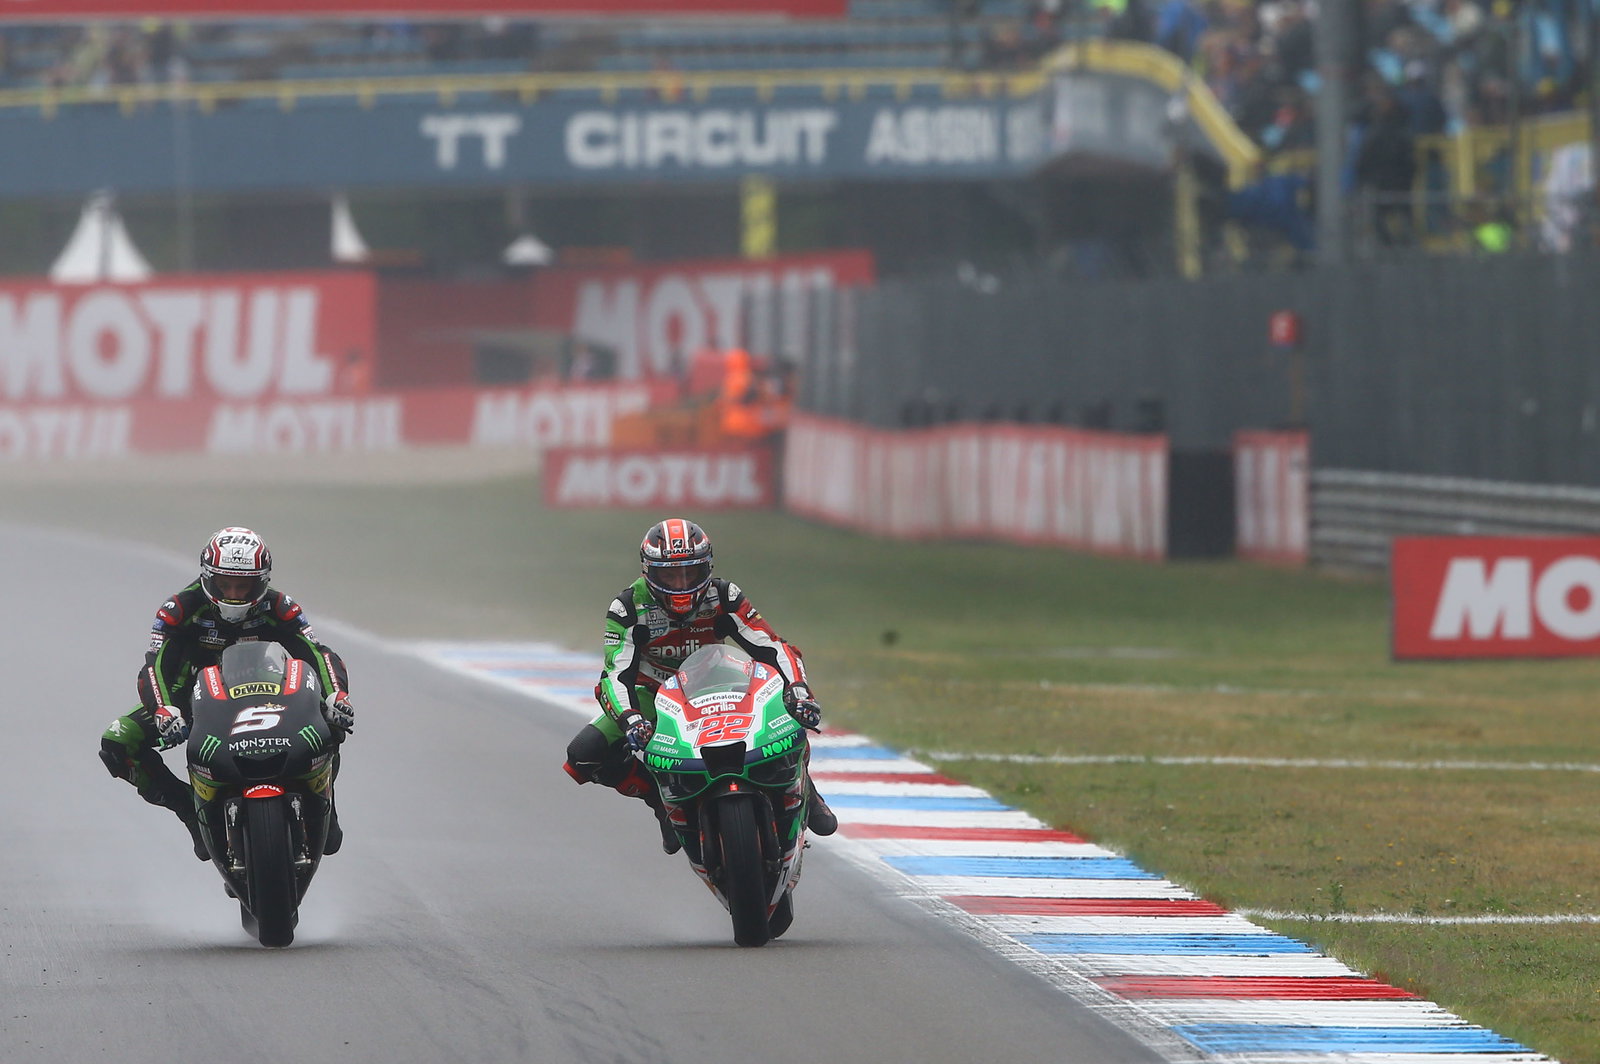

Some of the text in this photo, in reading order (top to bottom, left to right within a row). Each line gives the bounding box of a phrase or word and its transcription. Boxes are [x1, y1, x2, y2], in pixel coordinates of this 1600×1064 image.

[420, 114, 520, 168] TT
[565, 110, 837, 168] CIRCUIT
[0, 286, 336, 399] MOTUL
[558, 456, 762, 502] MOTUL
[649, 629, 664, 639] SAP
[289, 661, 298, 689] BARRACUDA
[692, 693, 743, 706] SuperEnalotto
[701, 703, 737, 715] aprilia
[231, 704, 287, 735] 5
[771, 715, 791, 727] MOTUL
[693, 714, 756, 748] 22
[776, 724, 795, 736] MARSH
[228, 737, 292, 752] MONSTER
[655, 735, 674, 743] MOTUL
[238, 748, 283, 757] ENERGY
[660, 746, 679, 755] MARSH
[761, 736, 793, 758] NOW
[647, 753, 674, 770] NOW
[245, 784, 282, 796] MOTUL
